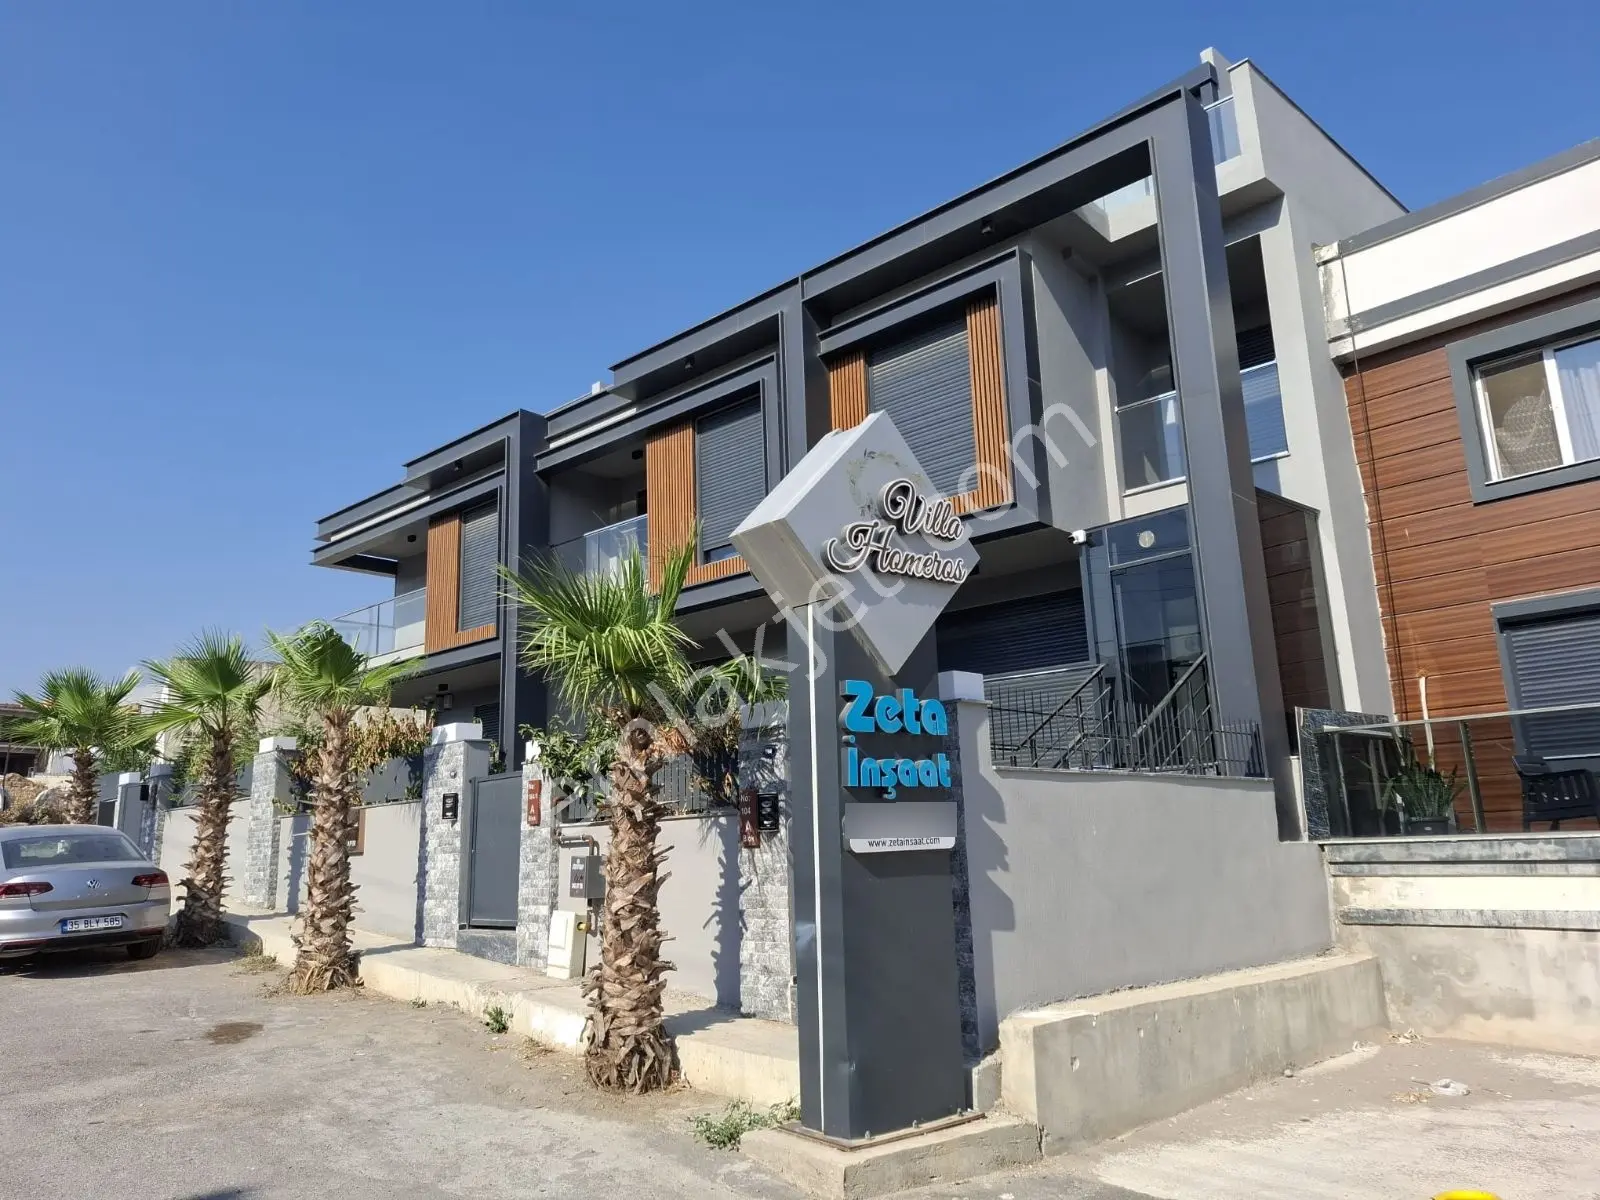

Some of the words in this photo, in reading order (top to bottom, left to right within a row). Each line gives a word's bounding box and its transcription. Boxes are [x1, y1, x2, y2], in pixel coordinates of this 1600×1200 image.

[882, 478, 964, 540] Villa
[826, 521, 969, 584] Homeros
[842, 680, 948, 735] Zeta
[844, 735, 952, 799] İnşaat
[68, 920, 80, 930] 35
[84, 918, 100, 928] BLY
